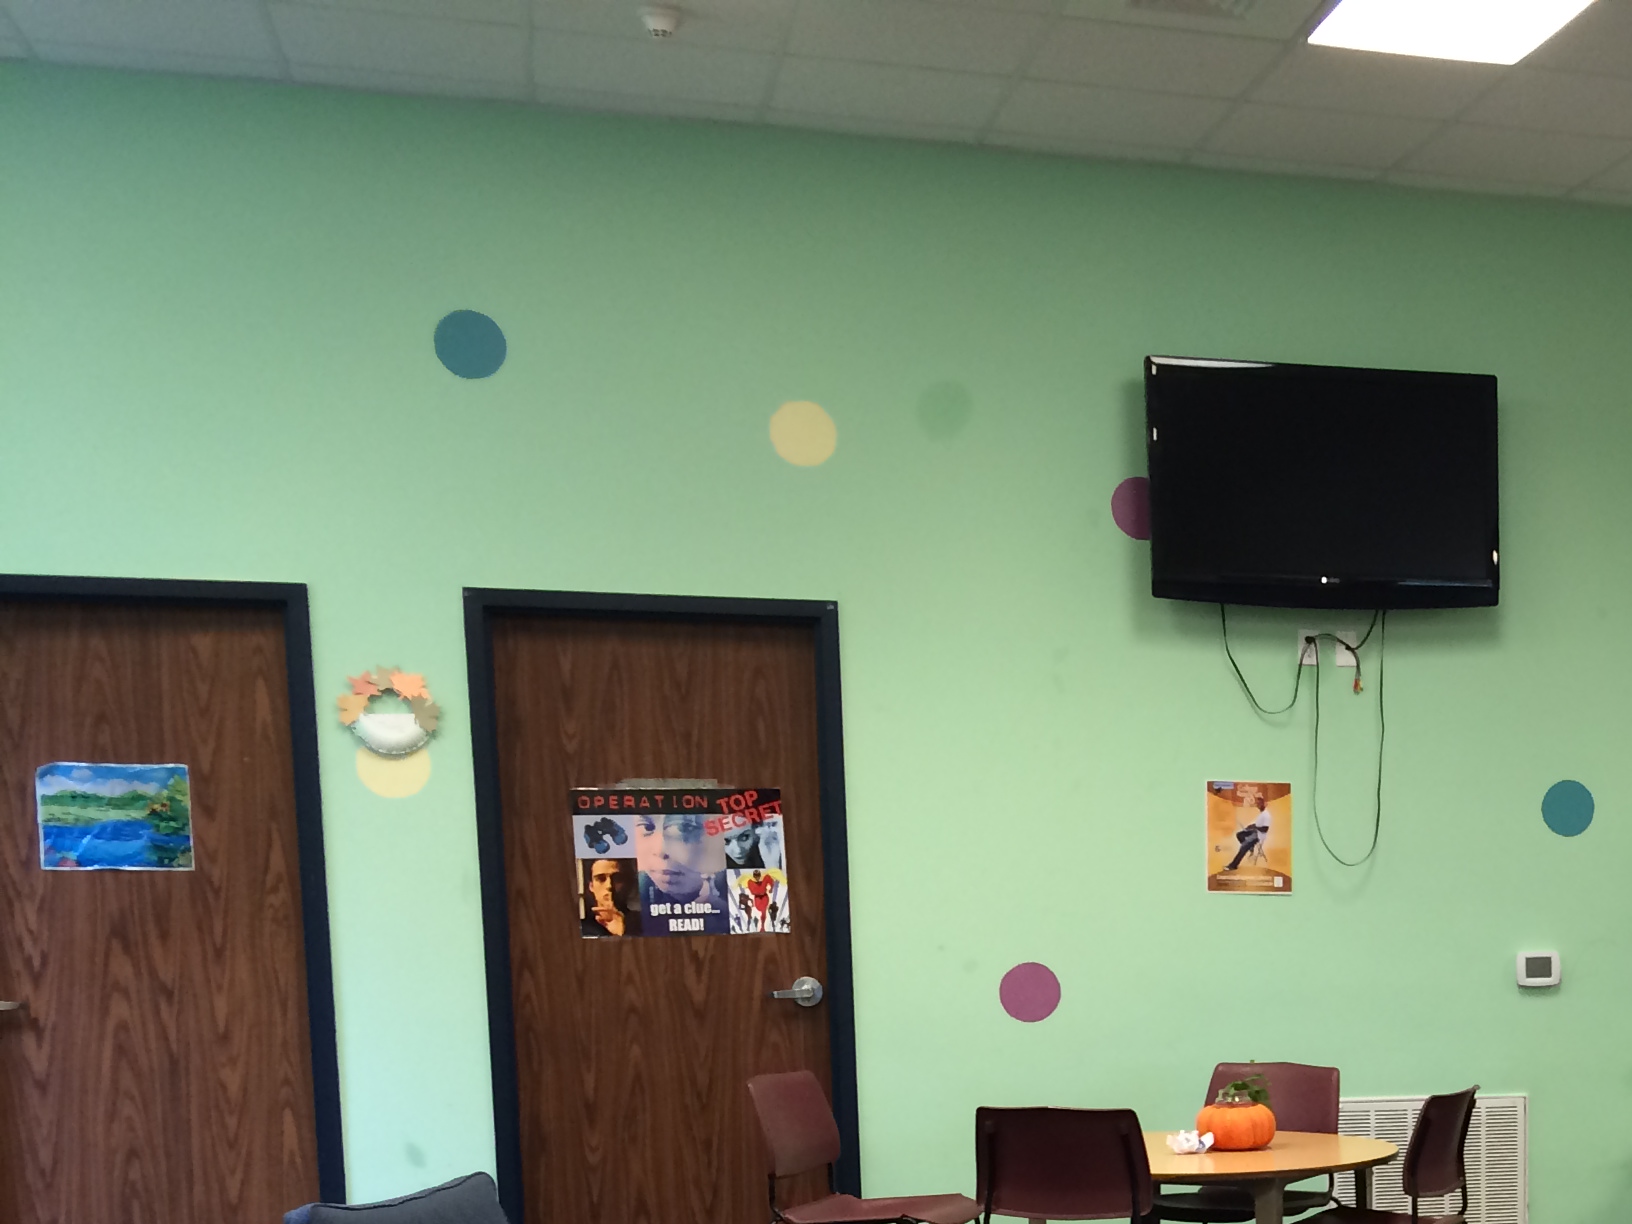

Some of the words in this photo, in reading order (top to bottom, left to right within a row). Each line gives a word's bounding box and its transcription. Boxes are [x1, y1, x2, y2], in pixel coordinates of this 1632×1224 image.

[577, 795, 708, 810] OPERATION
[716, 790, 758, 814] TOP
[704, 800, 782, 836] SECRET
[650, 902, 672, 916] get
[673, 903, 682, 914] a
[669, 918, 704, 932] READ!
